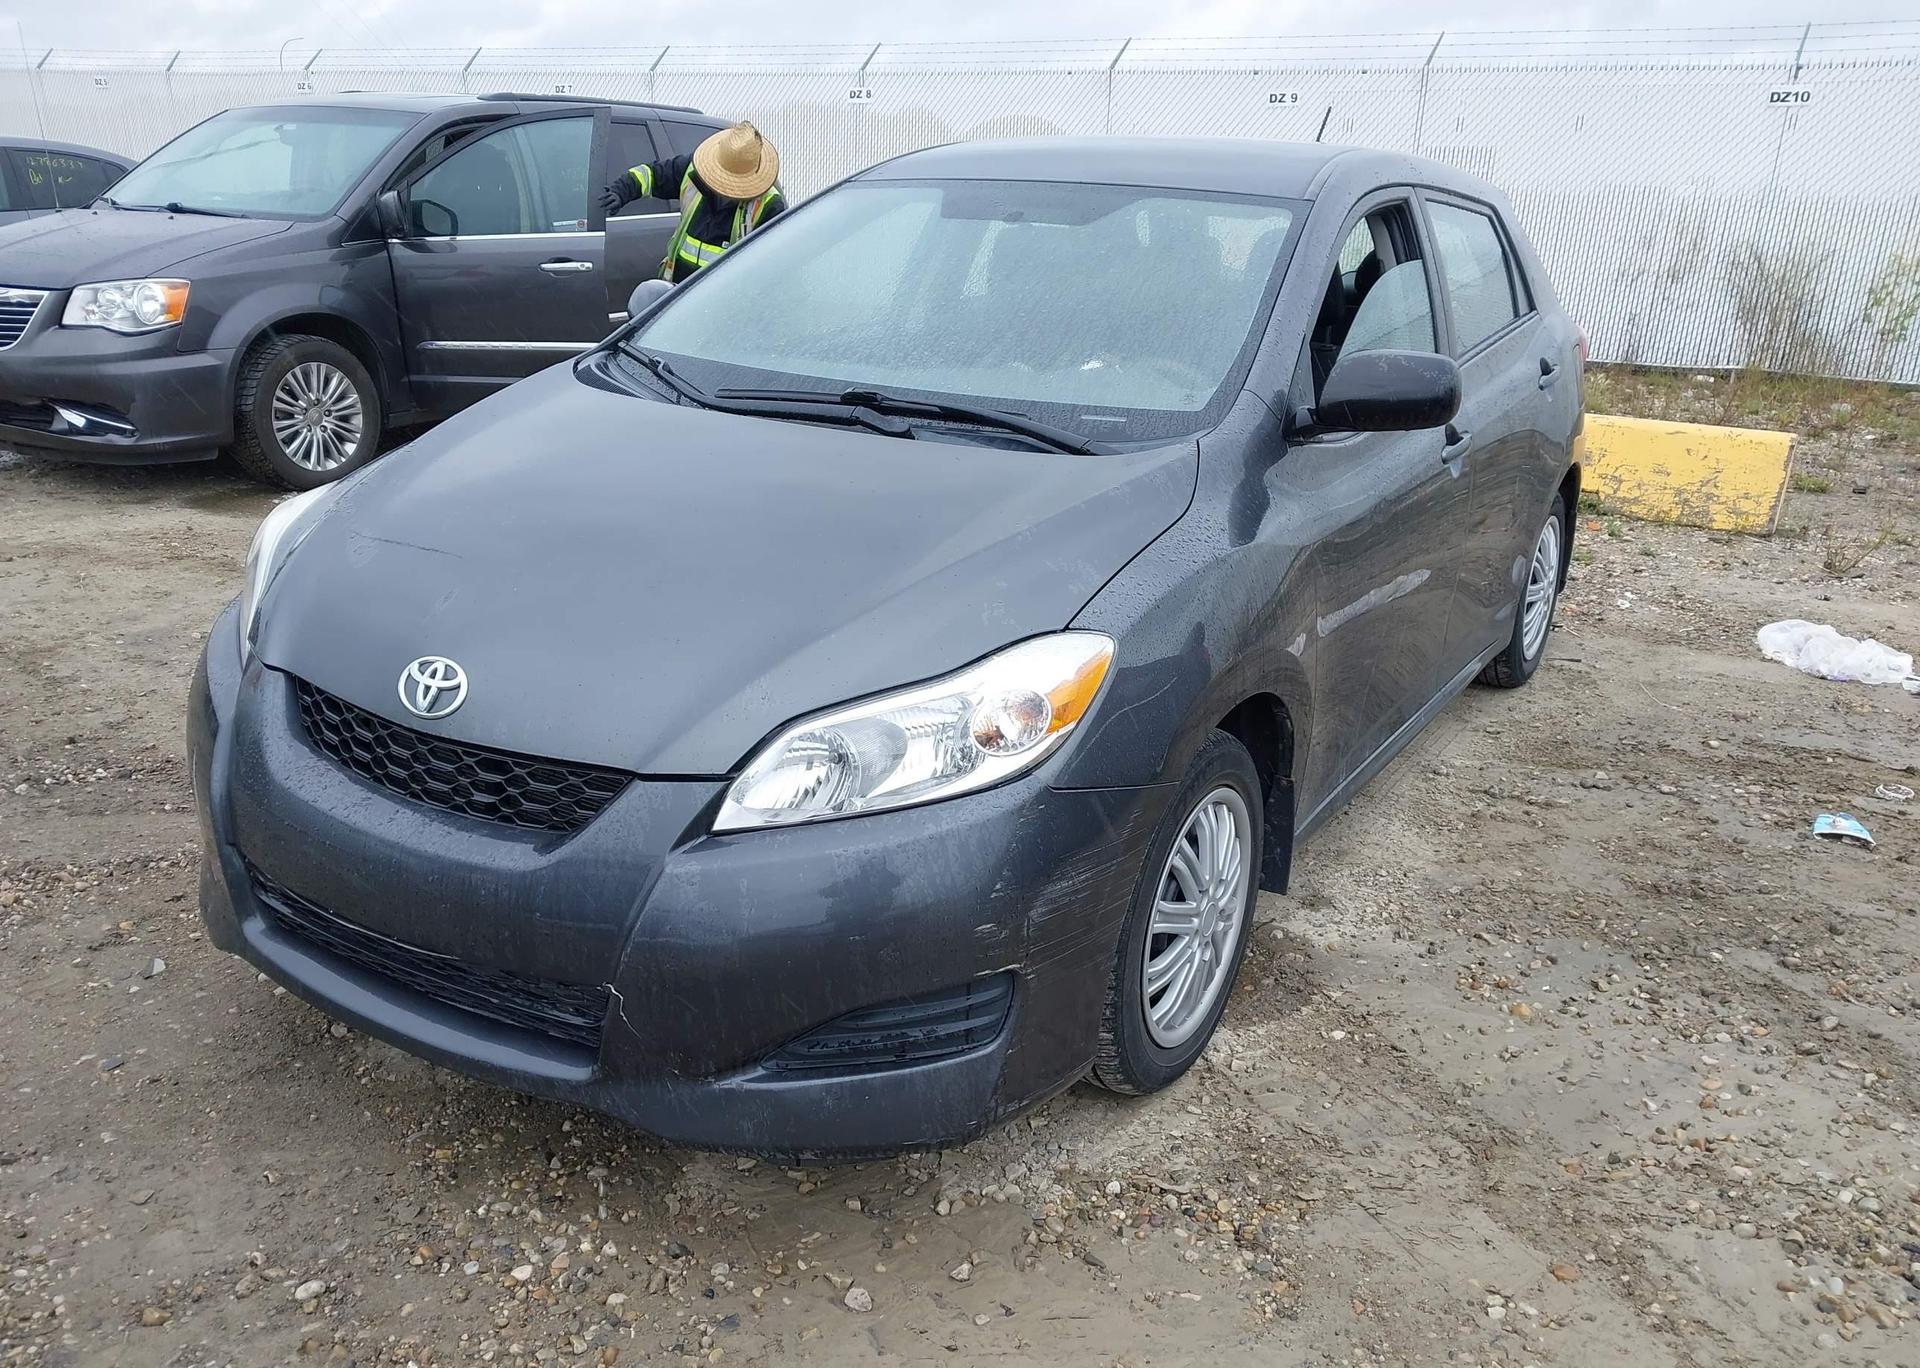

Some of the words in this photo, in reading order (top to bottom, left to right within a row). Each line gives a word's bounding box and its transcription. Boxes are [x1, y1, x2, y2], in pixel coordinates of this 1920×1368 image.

[555, 85, 566, 93] DZ
[849, 90, 863, 99] DZ
[865, 90, 872, 99] 8
[1269, 93, 1286, 103] DZ
[1290, 93, 1298, 103] 9
[1769, 91, 1811, 103] DZ10
